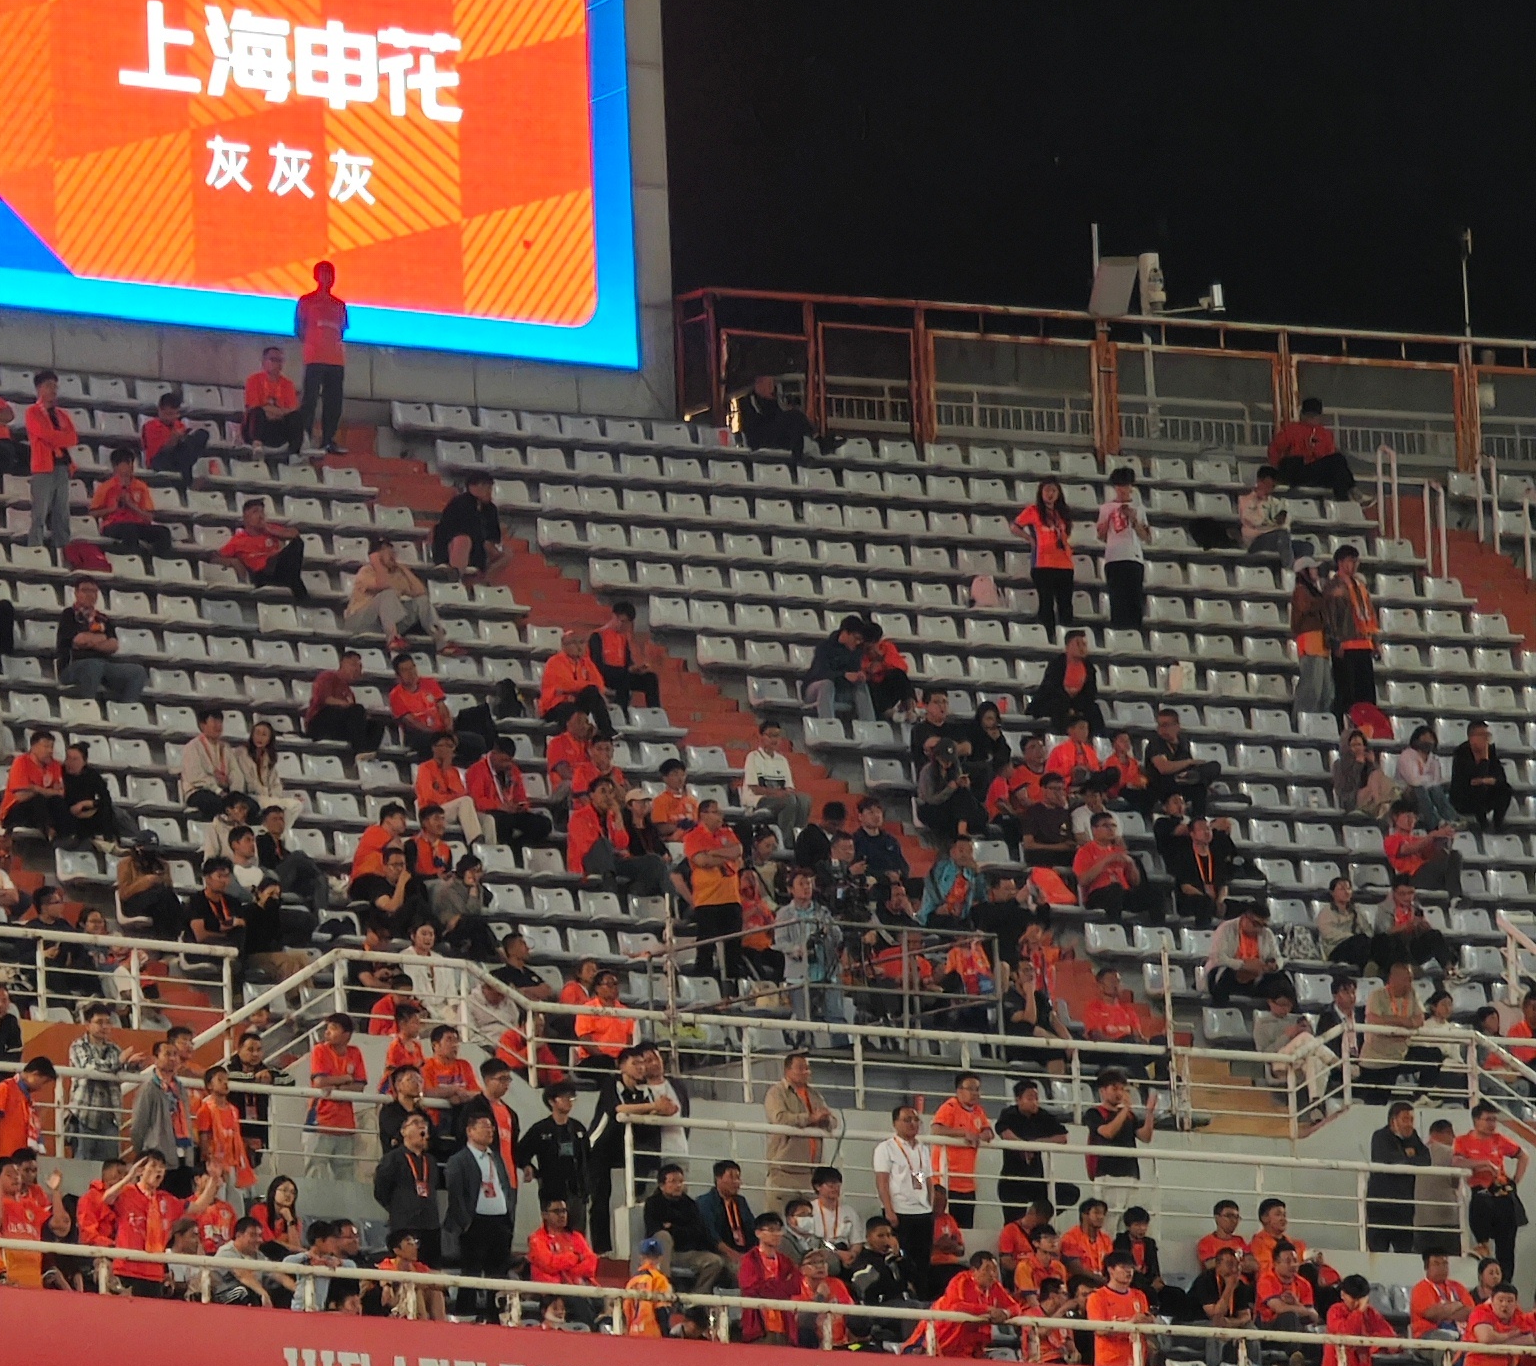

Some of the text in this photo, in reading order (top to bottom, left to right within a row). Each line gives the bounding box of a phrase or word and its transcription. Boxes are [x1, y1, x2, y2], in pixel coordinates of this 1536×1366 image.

[119, 0, 463, 122] 上海申花
[205, 135, 375, 204] 灰 灰 灰
